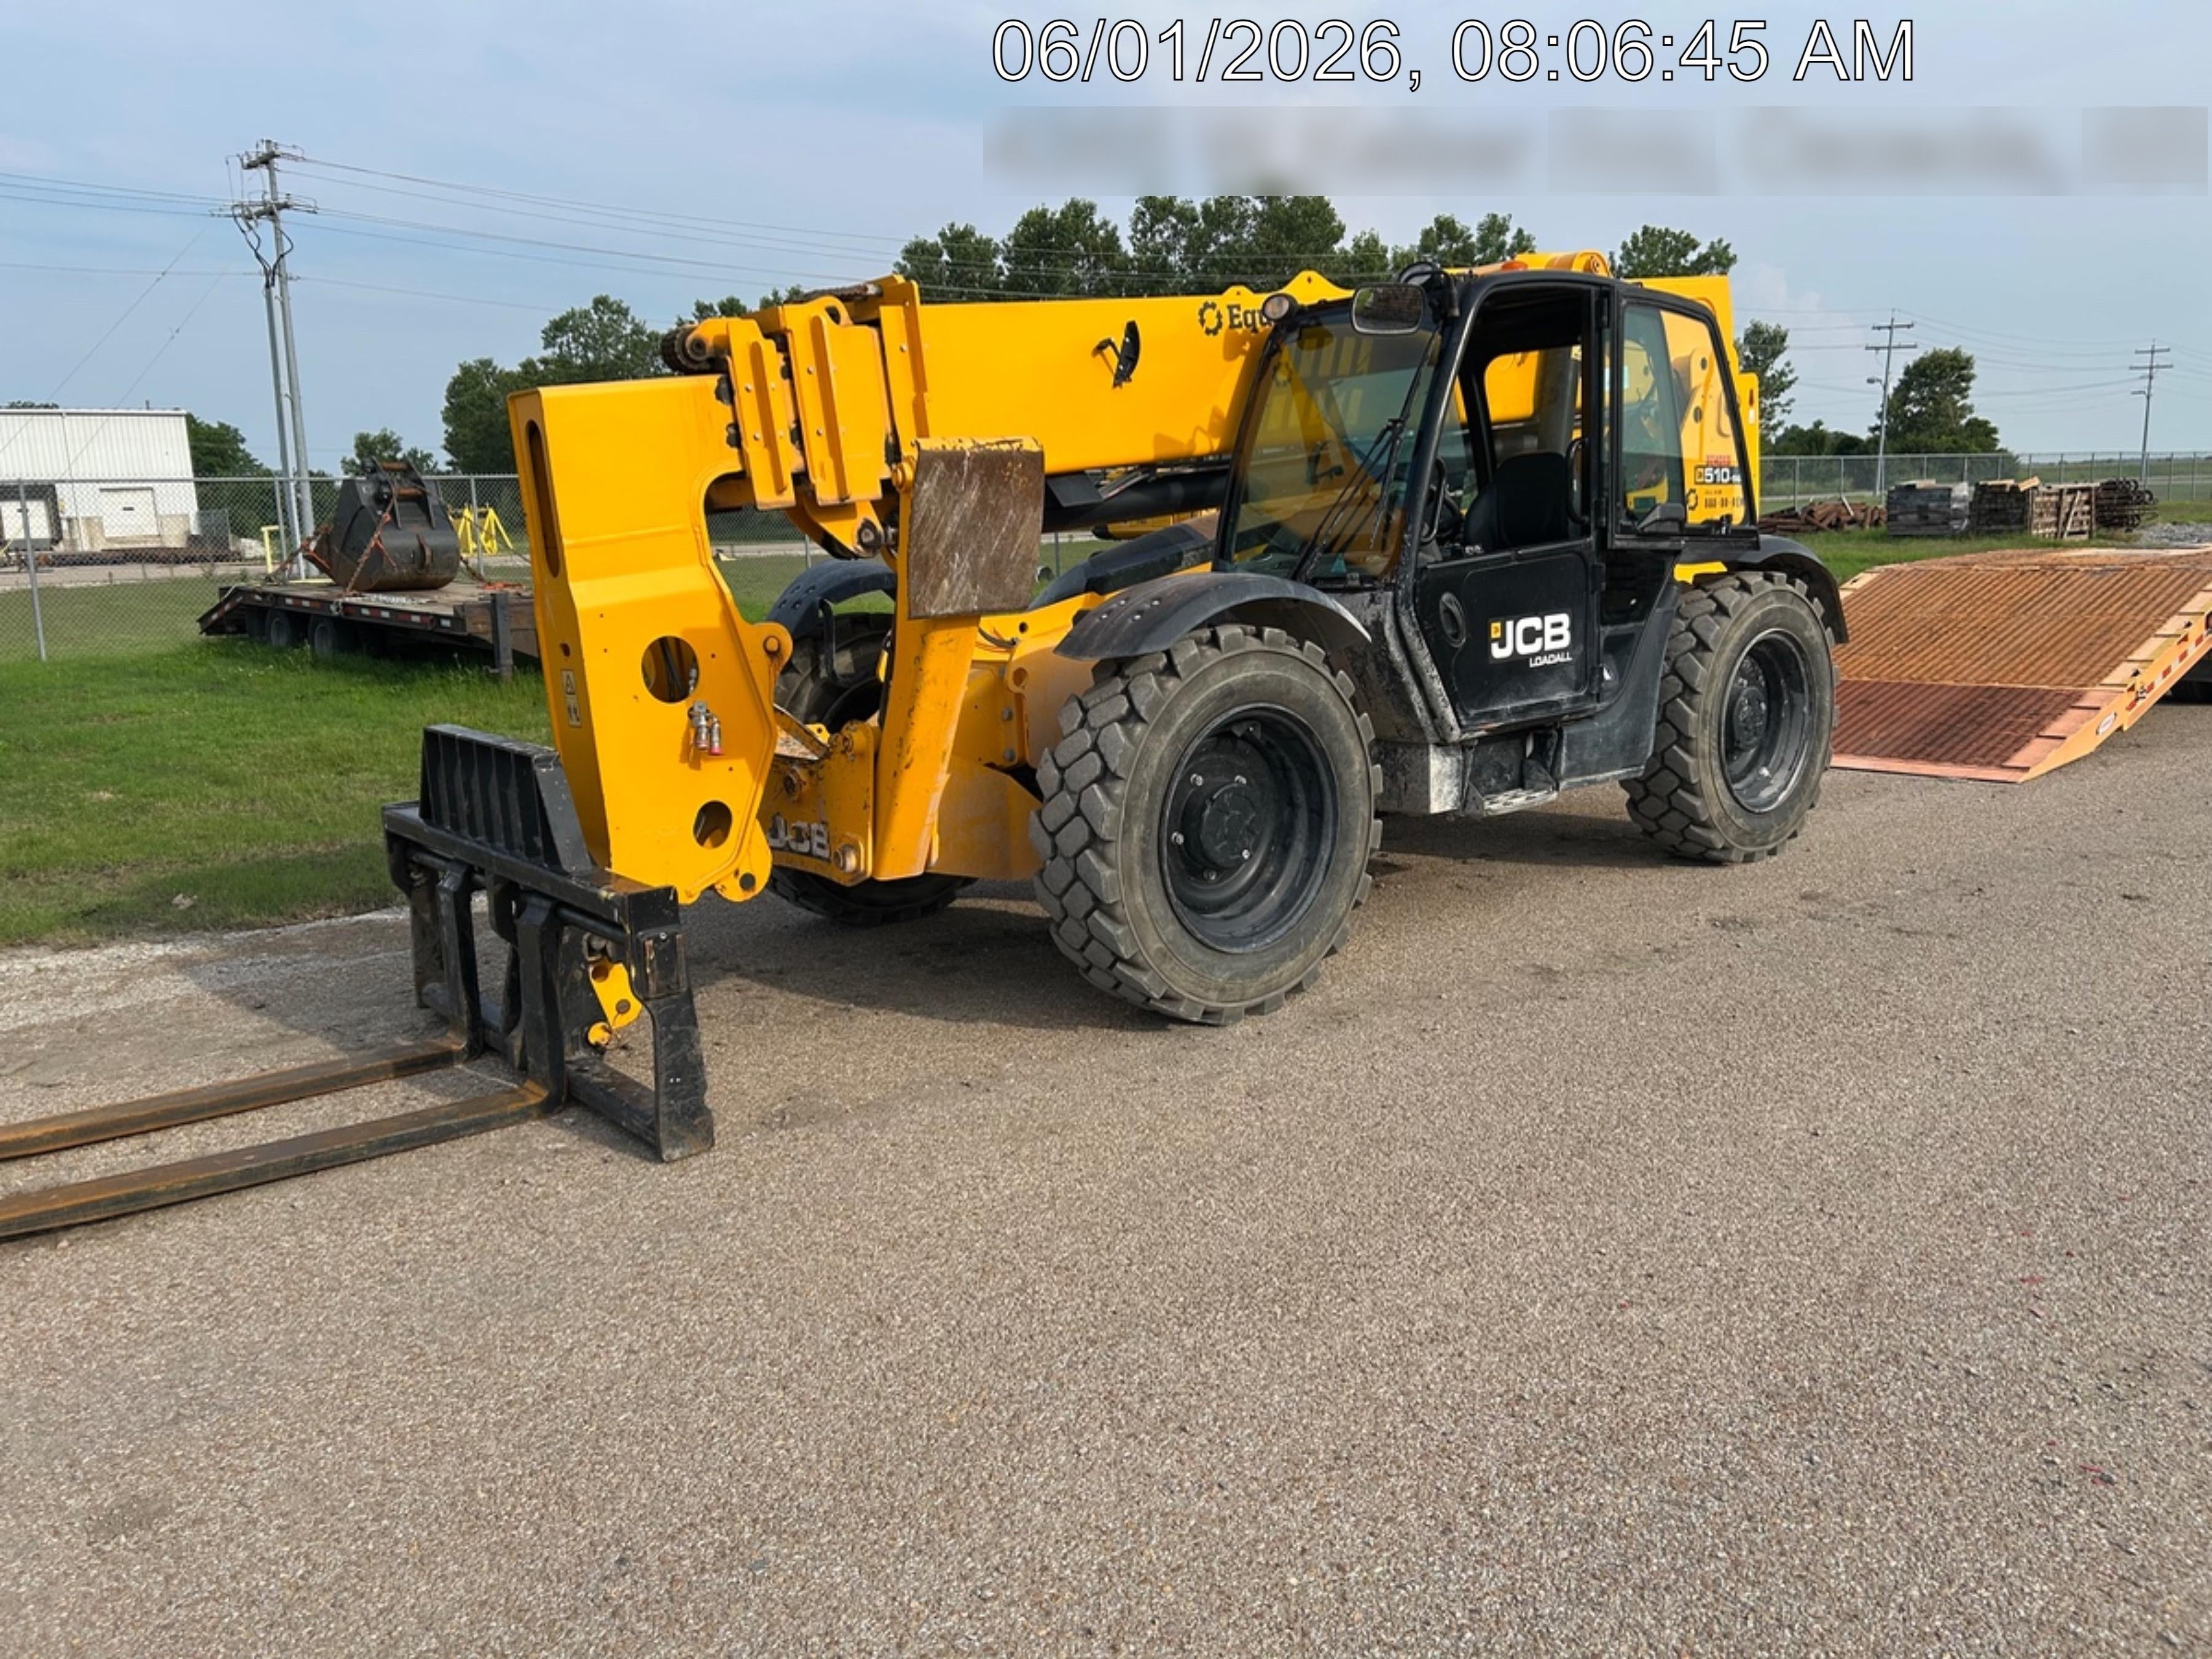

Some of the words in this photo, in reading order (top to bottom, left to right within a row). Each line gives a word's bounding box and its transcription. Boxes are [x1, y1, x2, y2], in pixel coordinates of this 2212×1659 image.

[1490, 613, 1571, 659] JCB
[1529, 651, 1573, 668] LOADALL
[767, 814, 831, 858] JCB
